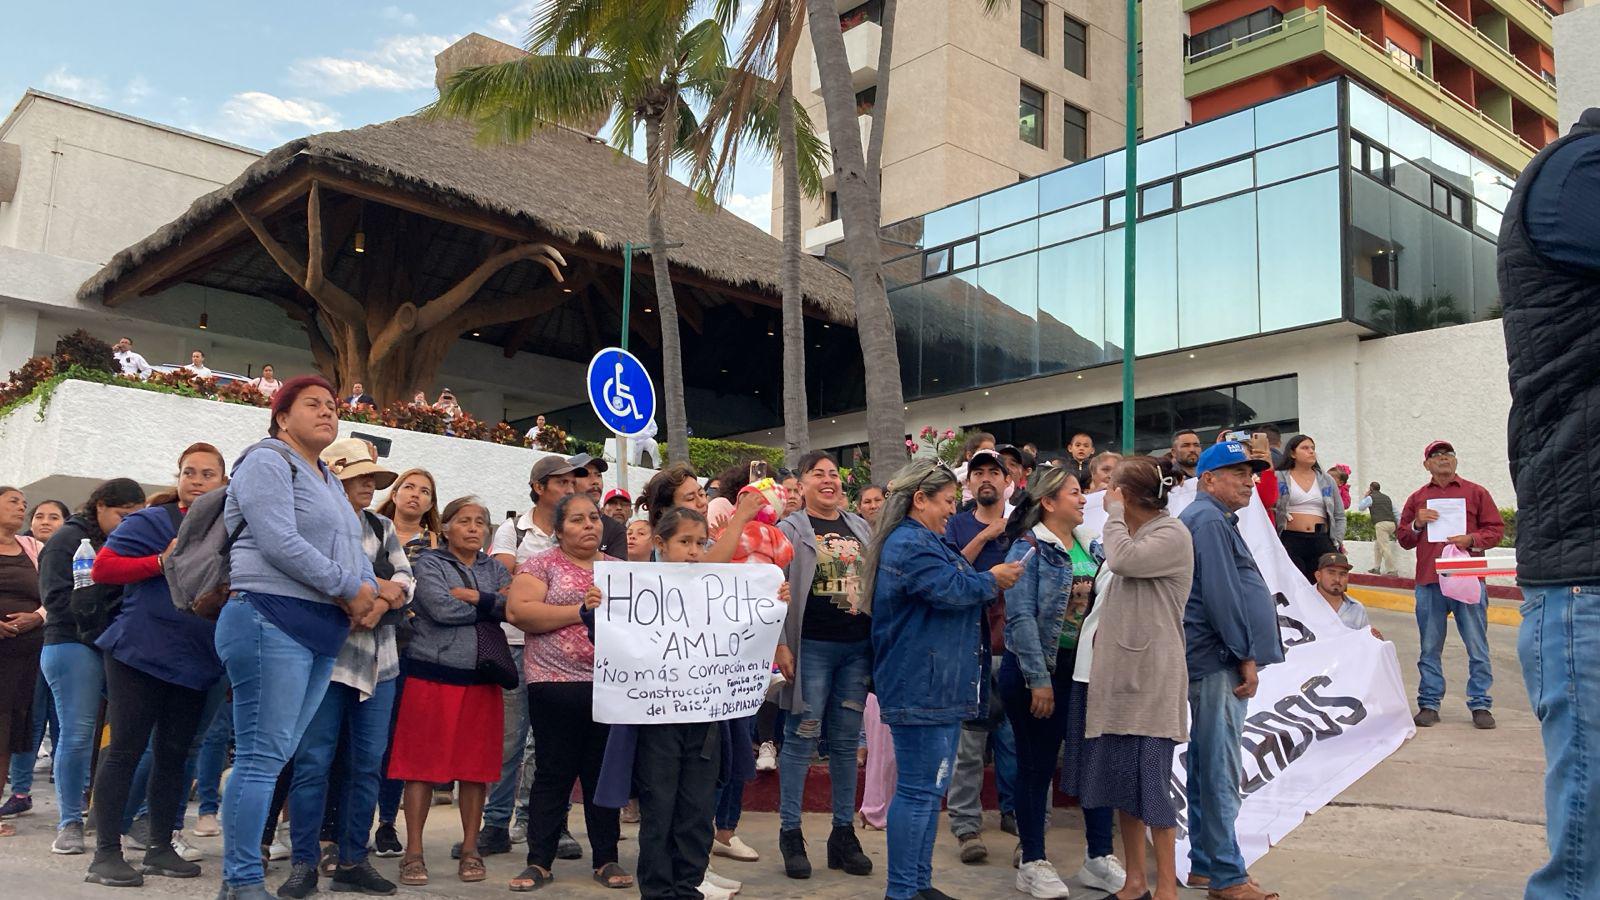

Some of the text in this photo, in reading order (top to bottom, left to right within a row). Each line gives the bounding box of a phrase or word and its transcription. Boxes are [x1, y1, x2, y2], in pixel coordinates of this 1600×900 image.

[607, 572, 781, 628] Hola Pdte.
[634, 664, 679, 682] más
[747, 662, 758, 671] en
[762, 659, 770, 670] la
[646, 703, 666, 716] del
